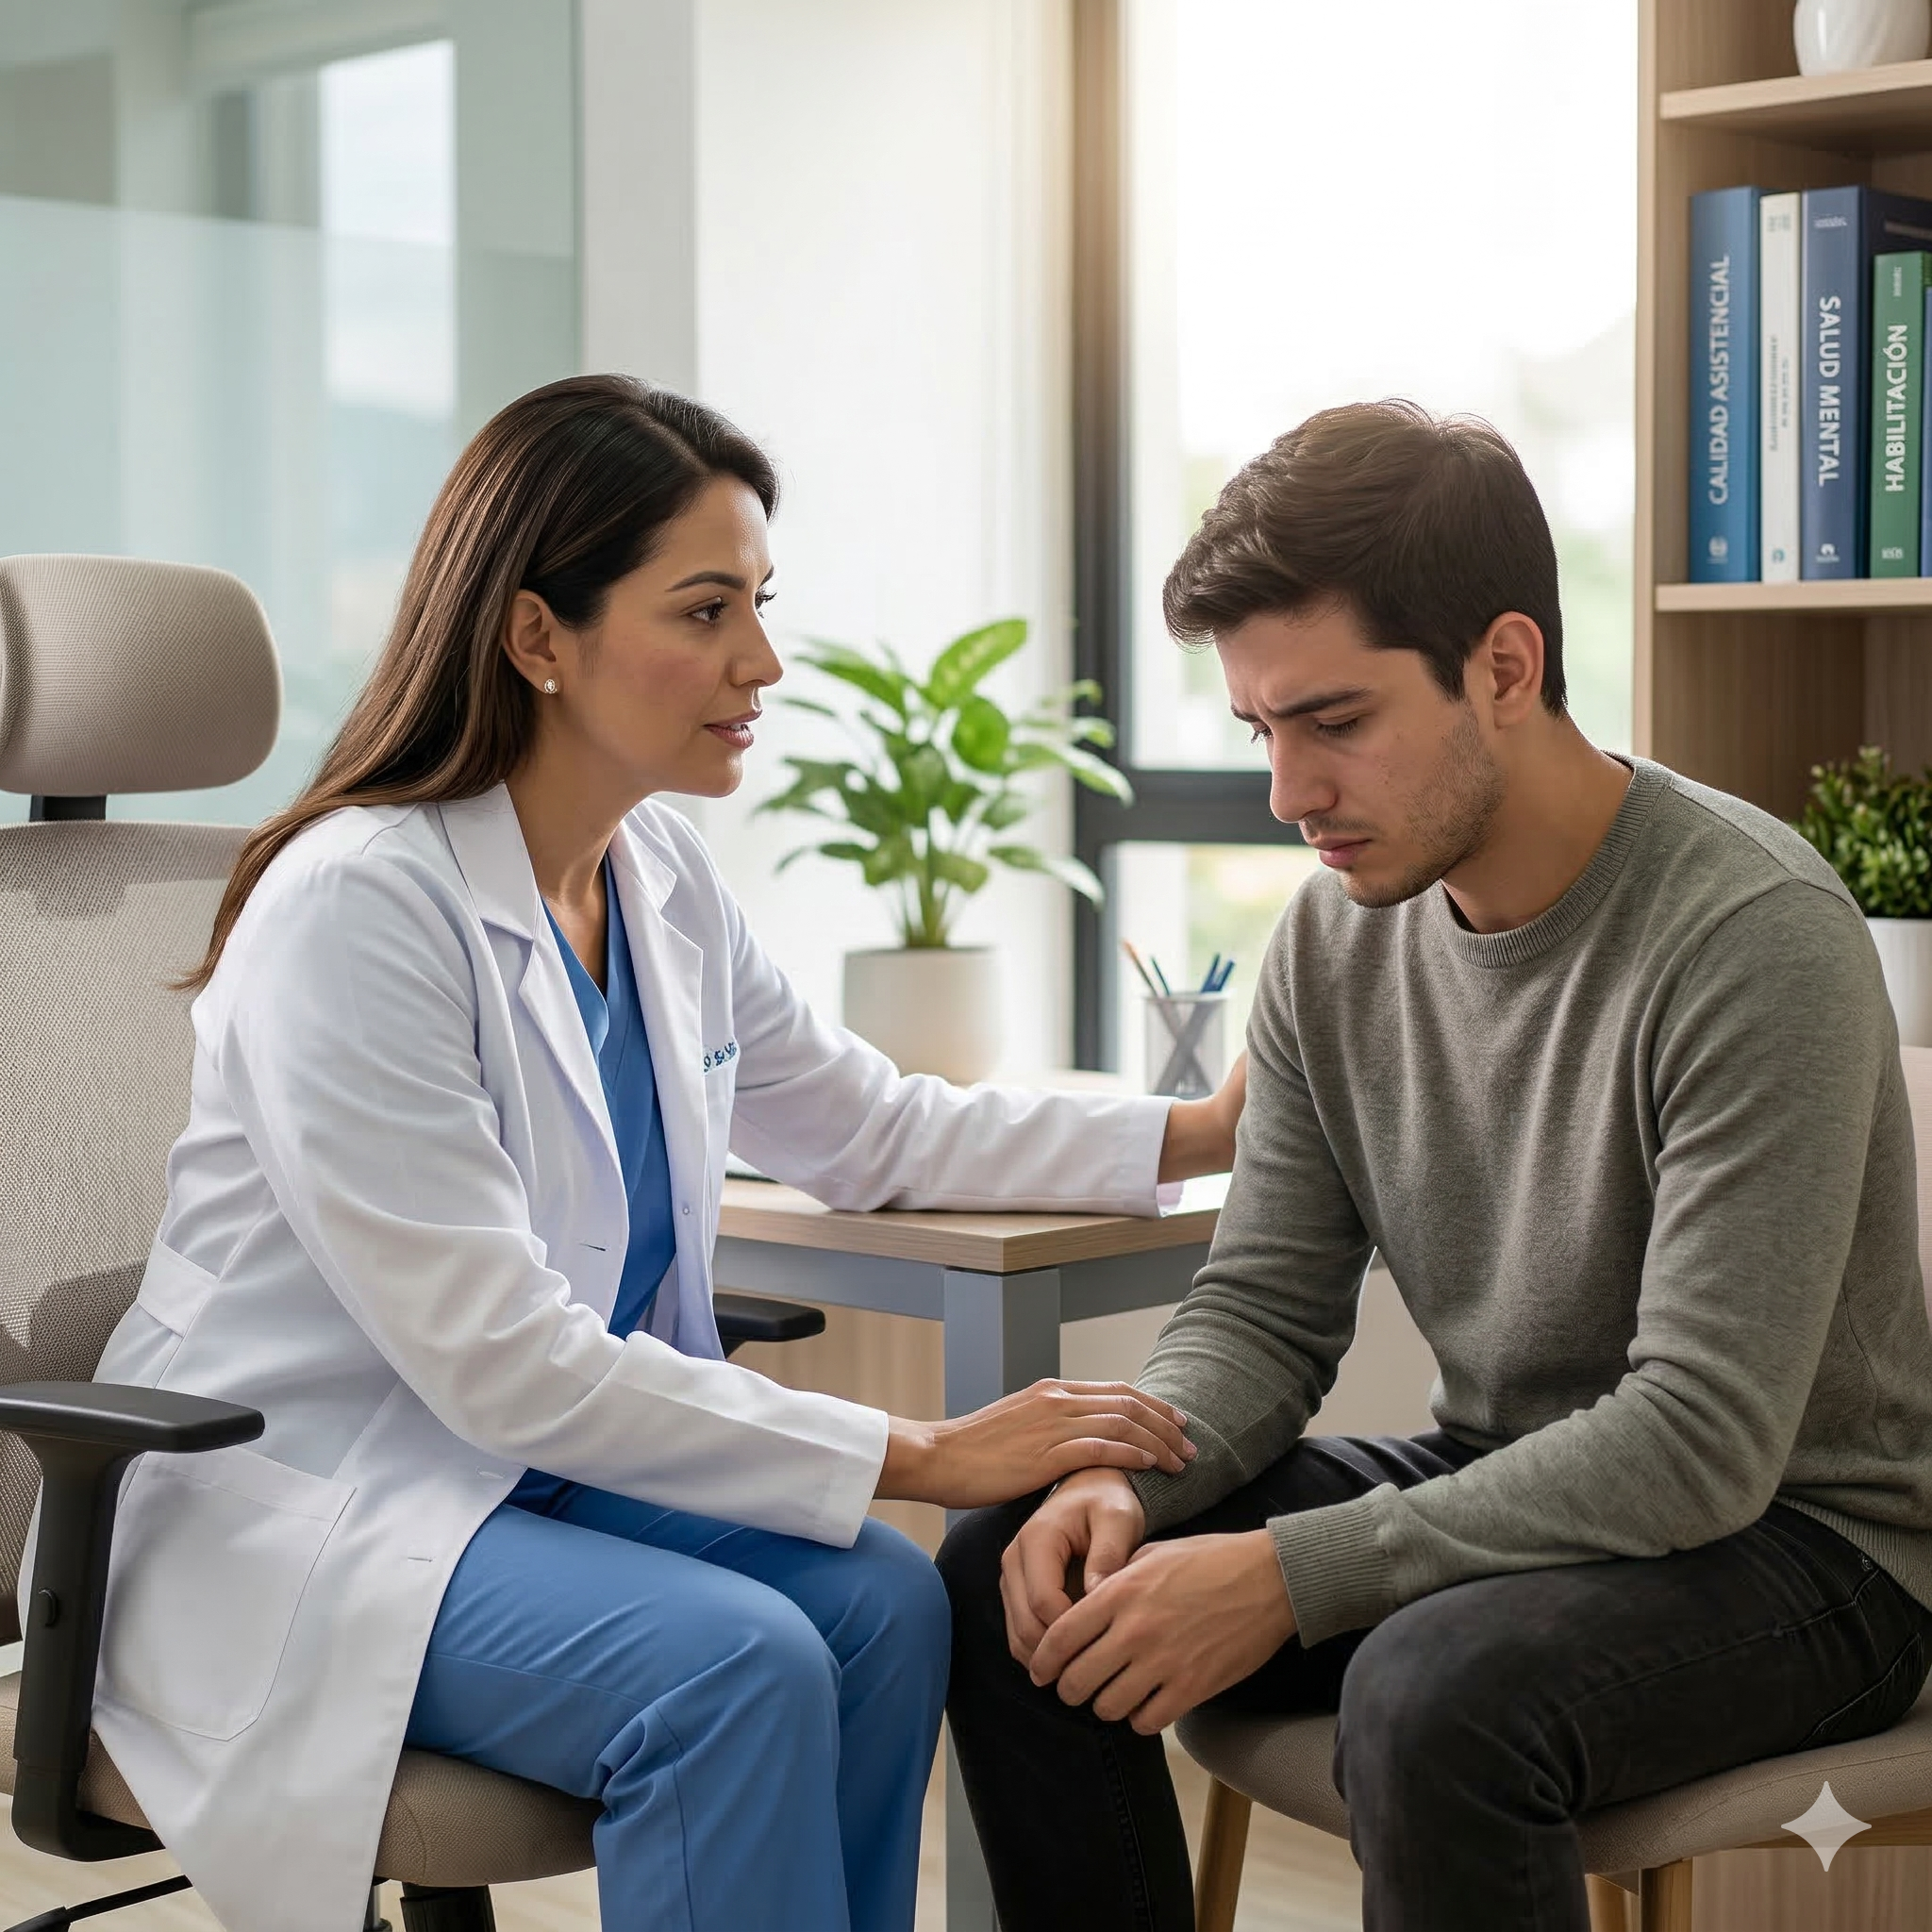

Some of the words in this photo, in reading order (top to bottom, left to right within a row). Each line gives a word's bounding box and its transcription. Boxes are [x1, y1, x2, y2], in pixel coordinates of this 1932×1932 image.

[1708, 255, 1730, 400] ASISTENCIAL
[1819, 295, 1840, 377] SALUD
[1708, 406, 1729, 505] CALIDAD
[1819, 385, 1840, 487] MENTAL
[1883, 325, 1907, 492] HABILITACIÓN
